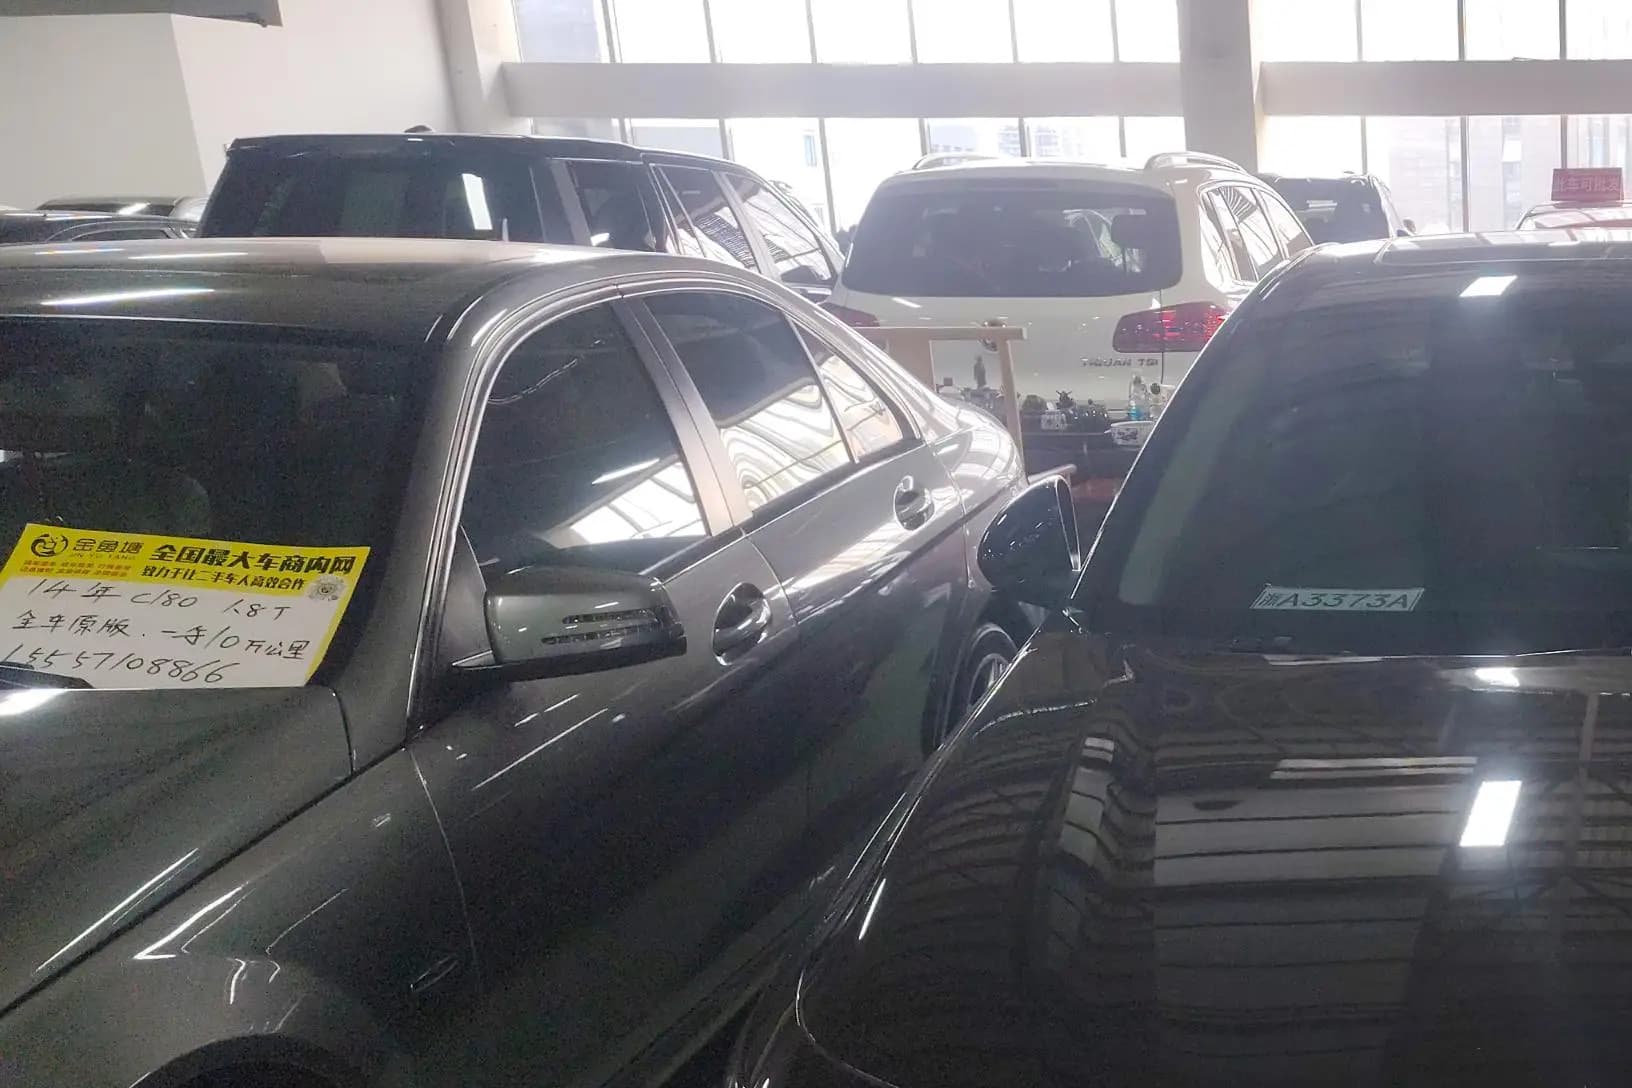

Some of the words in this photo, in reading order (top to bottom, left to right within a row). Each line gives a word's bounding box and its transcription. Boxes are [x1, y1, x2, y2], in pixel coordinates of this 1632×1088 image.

[149, 544, 357, 575] 全国最大车商内网
[141, 565, 305, 591] 致力于让二手车人高效合作
